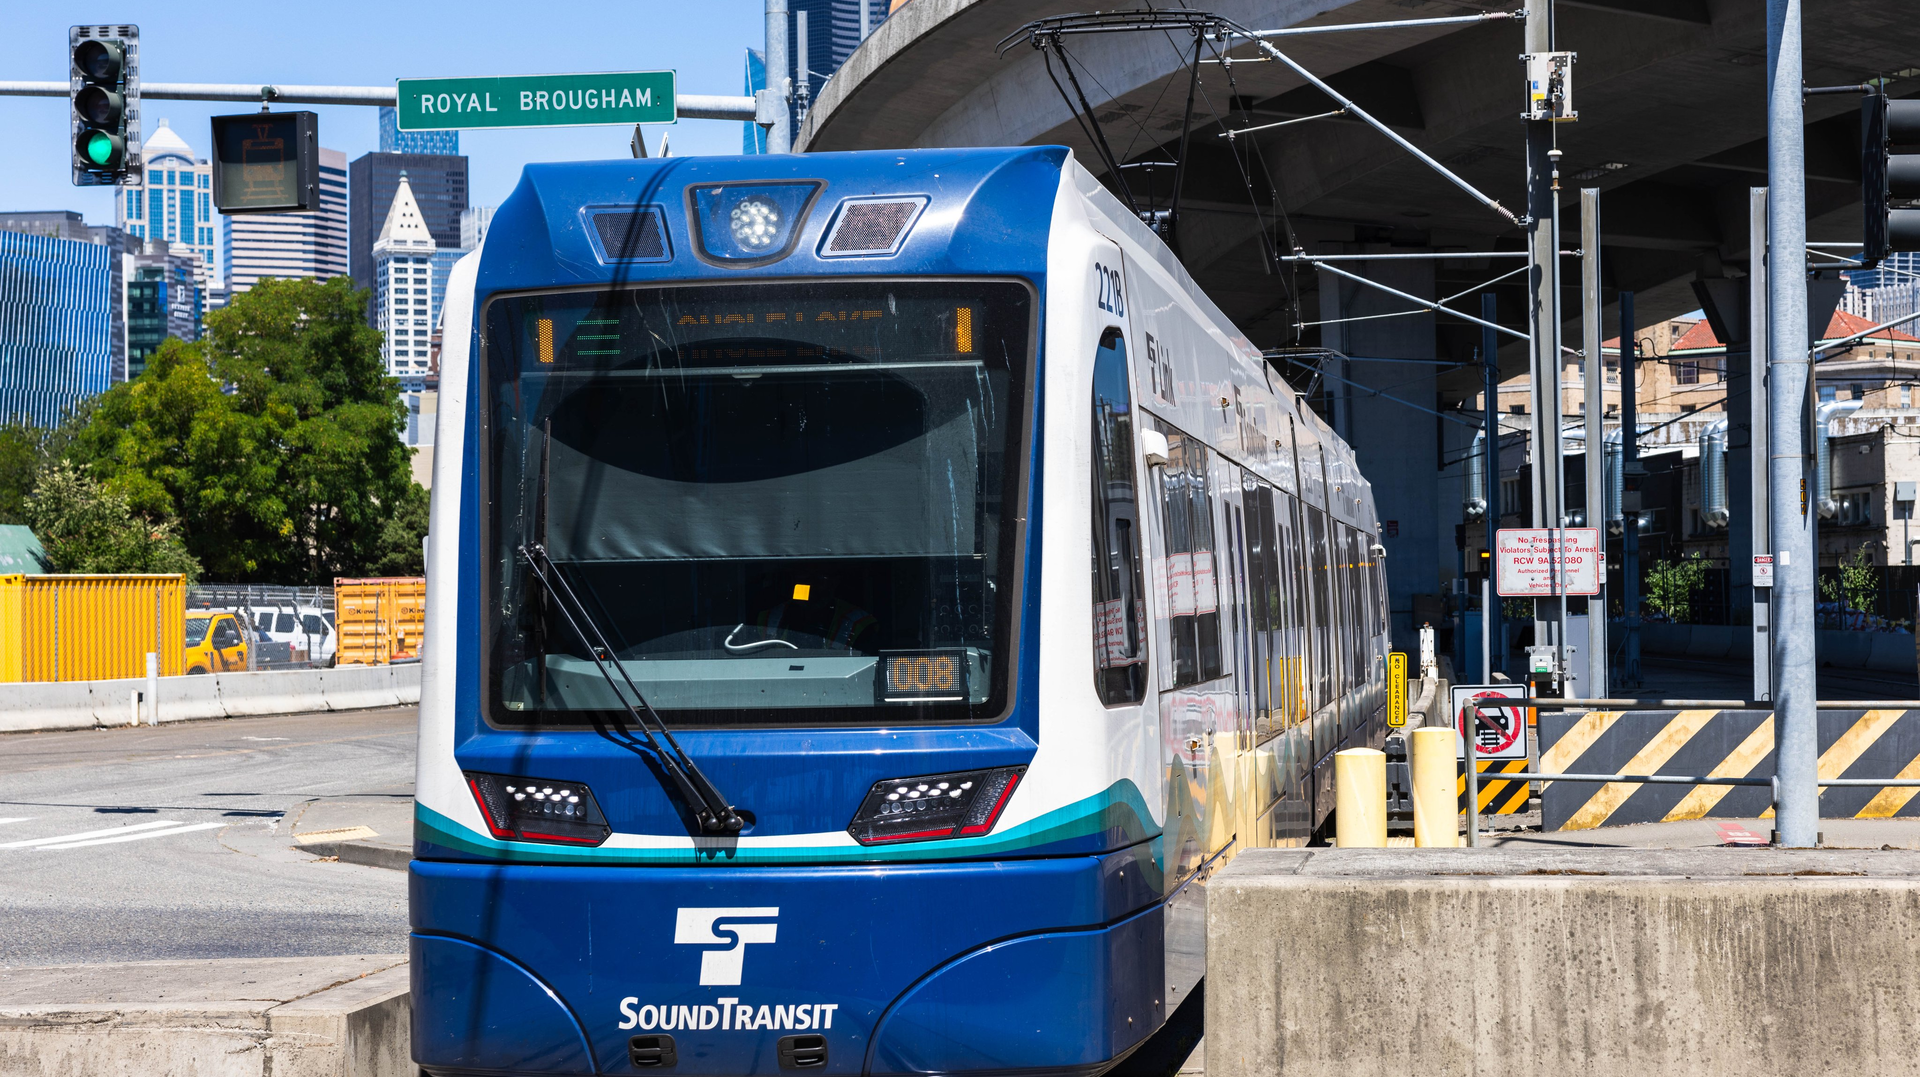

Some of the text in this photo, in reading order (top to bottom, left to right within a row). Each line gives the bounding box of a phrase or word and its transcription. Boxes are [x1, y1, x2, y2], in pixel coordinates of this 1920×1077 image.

[421, 88, 651, 114] ROYAL BROUGHAM
[1095, 262, 1124, 318] 221B
[1533, 546, 1560, 554] Subject
[894, 656, 952, 690] 008
